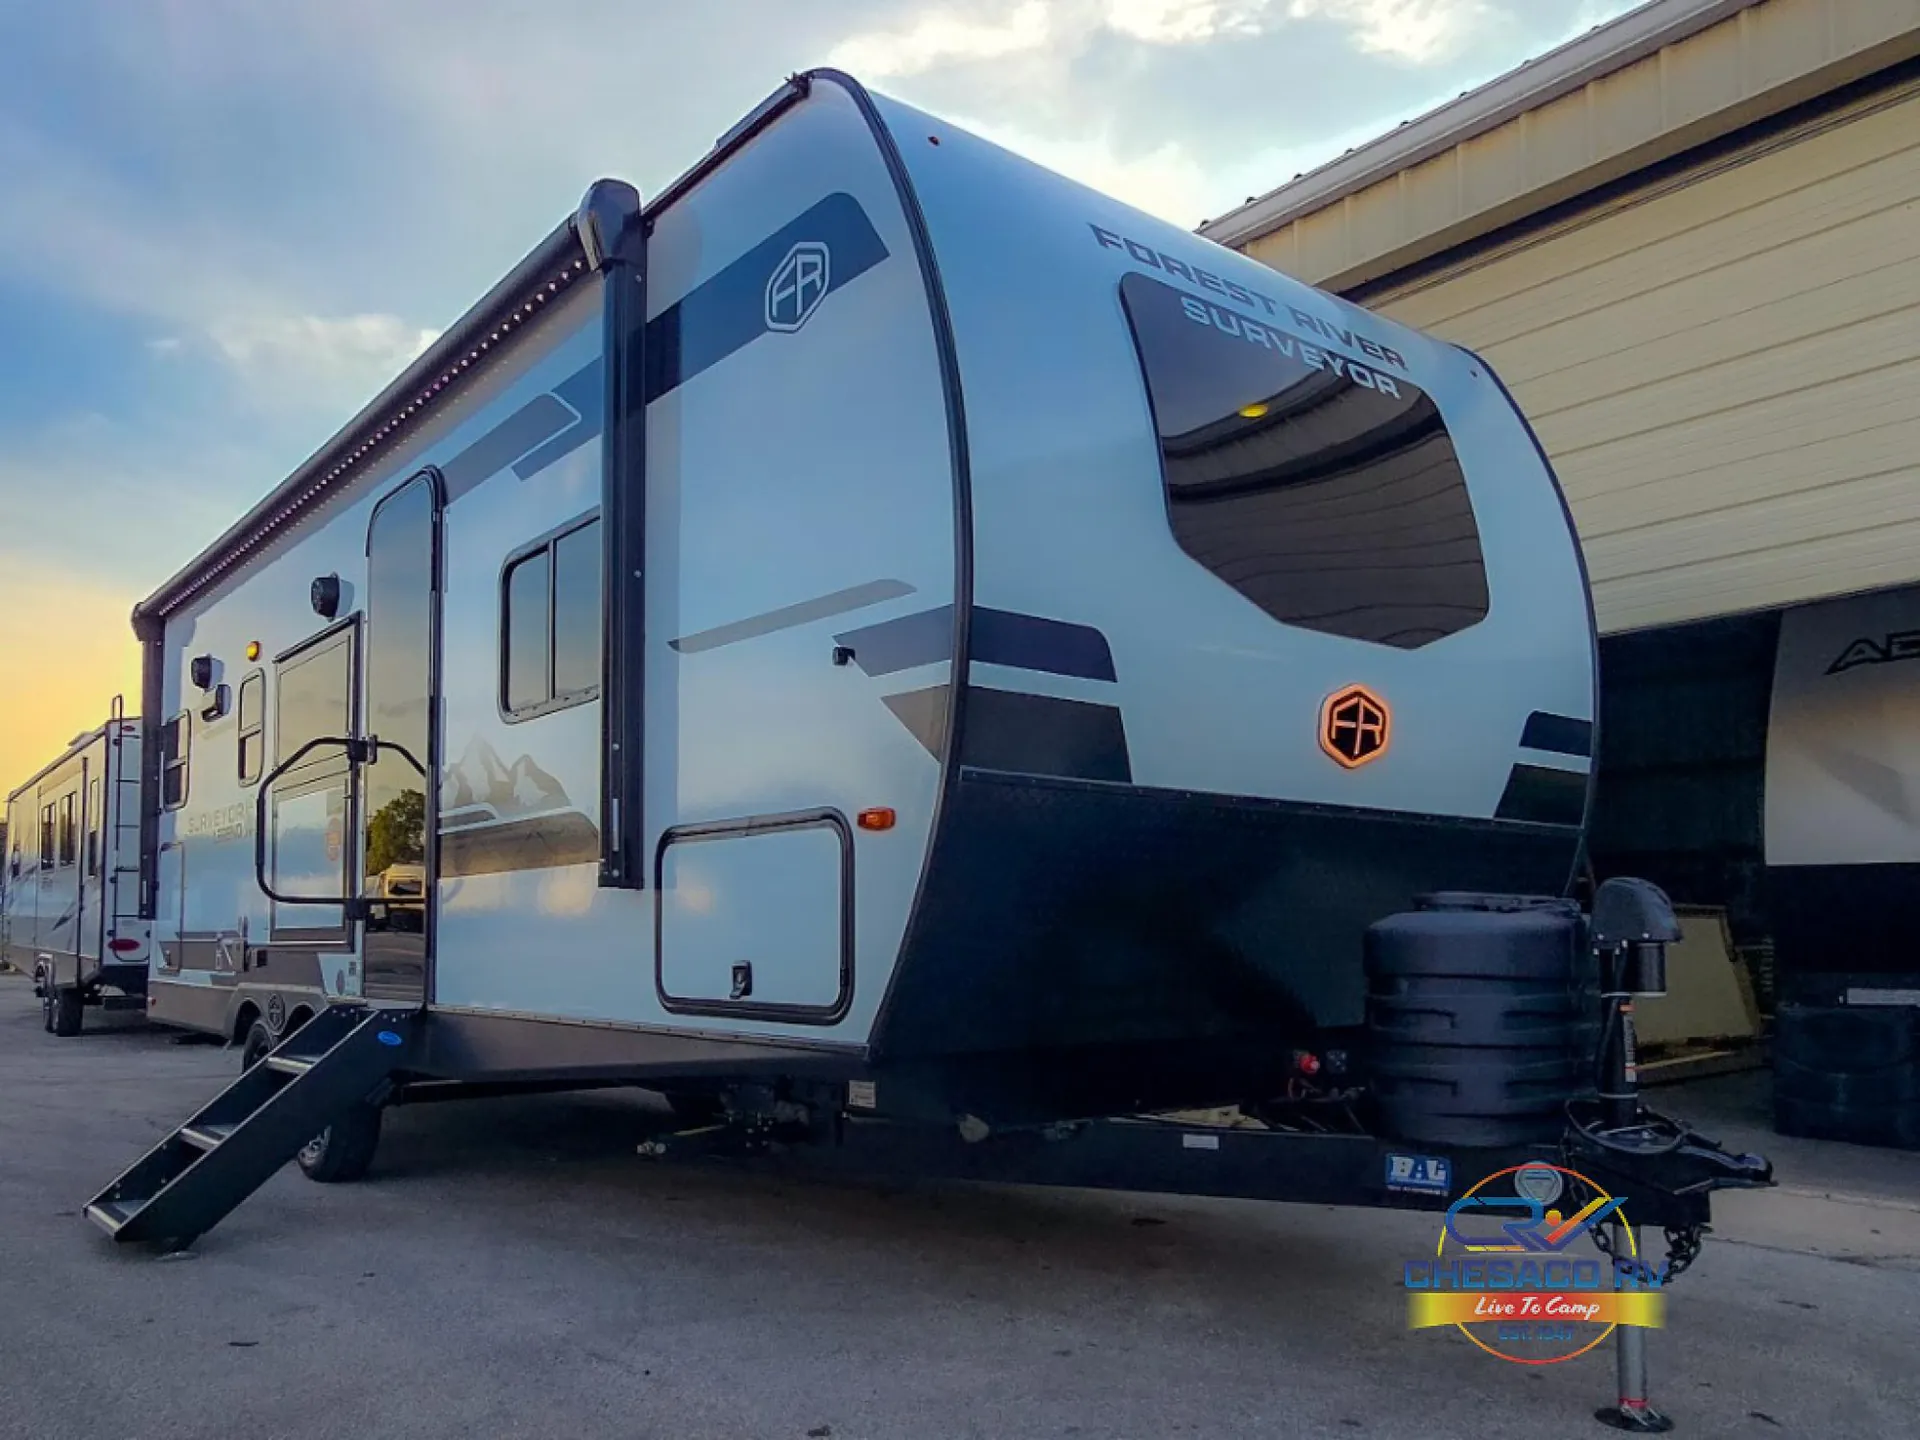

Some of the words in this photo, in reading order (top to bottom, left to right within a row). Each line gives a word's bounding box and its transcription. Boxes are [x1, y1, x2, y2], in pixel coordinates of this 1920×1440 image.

[1088, 222, 1277, 316] FOREST
[1284, 304, 1409, 371] RIVER
[1180, 296, 1402, 400] SURVEYOR
